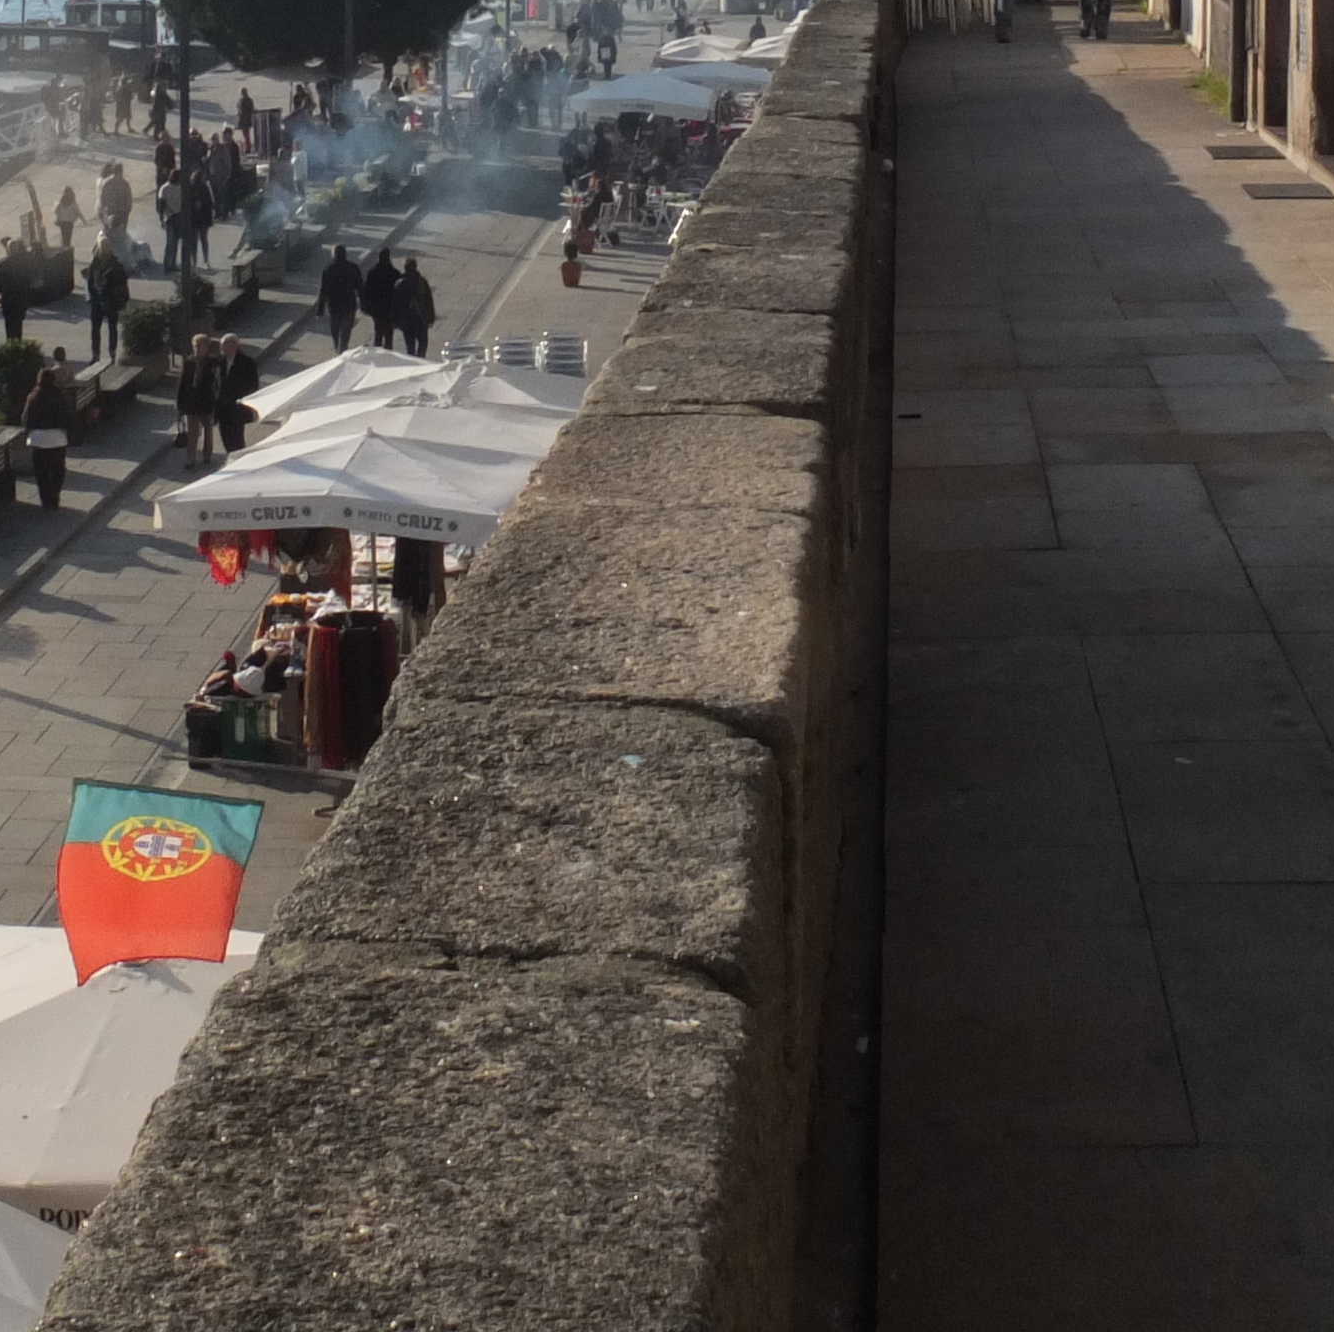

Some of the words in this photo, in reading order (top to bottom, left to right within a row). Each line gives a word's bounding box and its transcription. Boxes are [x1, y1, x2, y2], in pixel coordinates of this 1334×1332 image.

[212, 510, 247, 521] PORTO
[250, 506, 298, 522] CRUZ
[357, 509, 392, 523] PORTO
[396, 513, 444, 531] CRUZ
